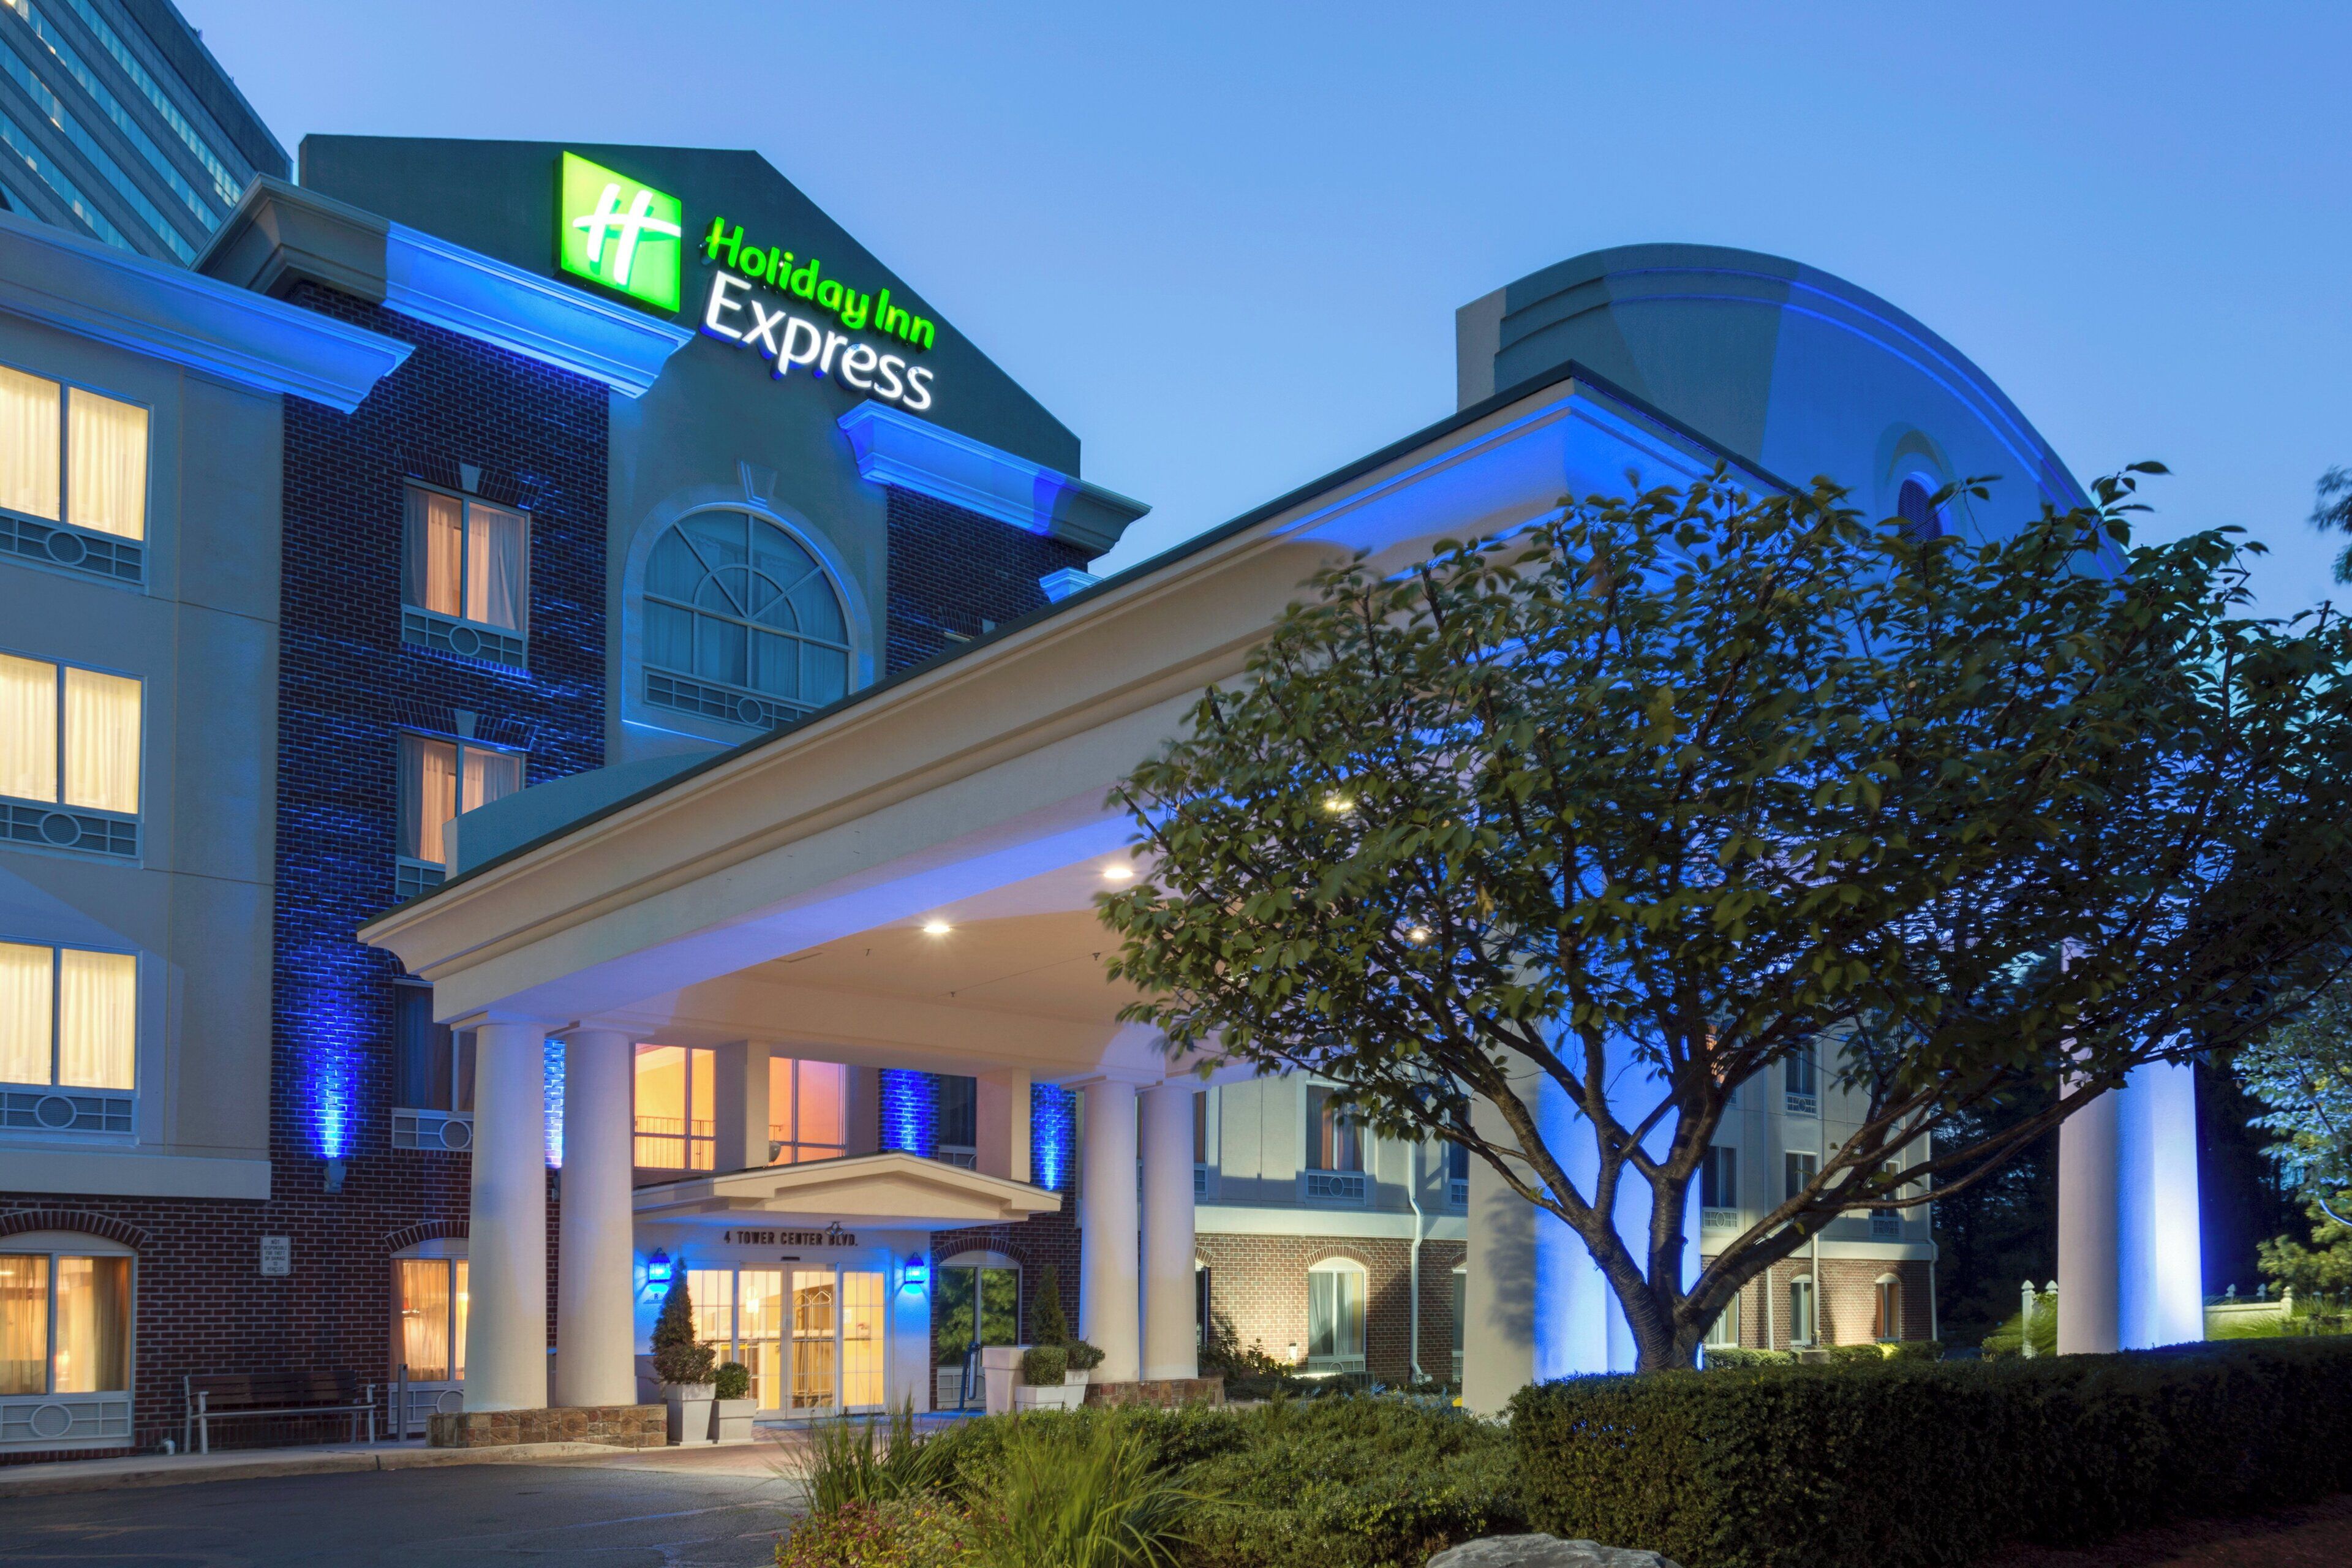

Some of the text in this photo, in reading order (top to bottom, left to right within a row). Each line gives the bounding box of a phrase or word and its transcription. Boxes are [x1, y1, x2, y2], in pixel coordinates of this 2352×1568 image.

[704, 270, 934, 411] Express
[705, 216, 936, 350] Holiday Inn
[723, 1230, 858, 1246] 4 TOWER CENTER BLVD.
